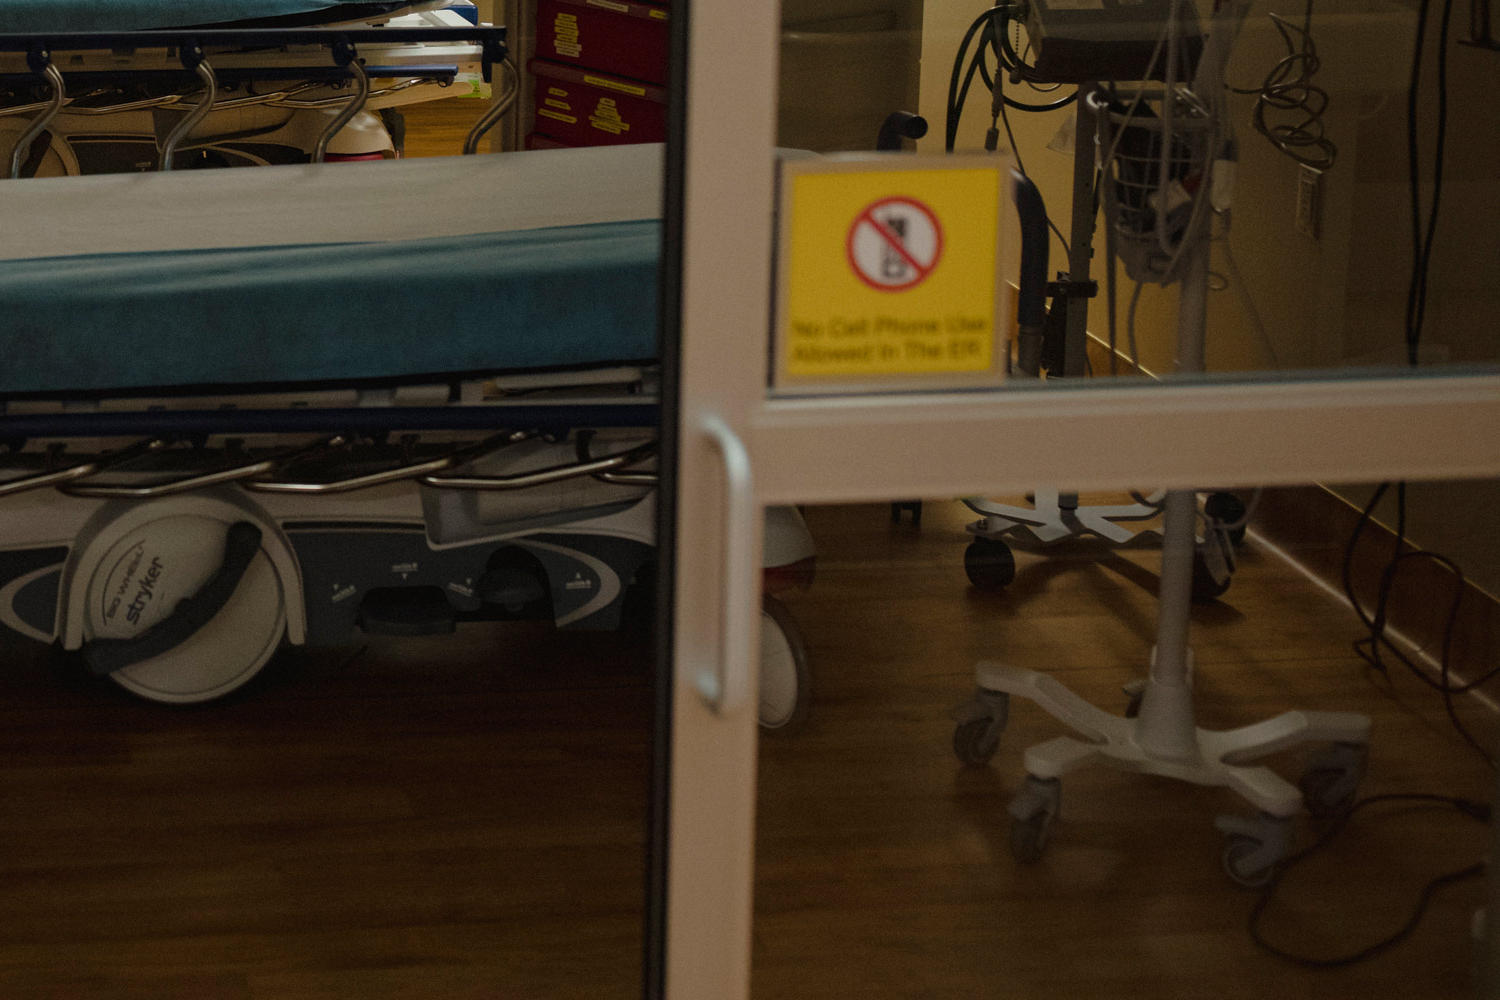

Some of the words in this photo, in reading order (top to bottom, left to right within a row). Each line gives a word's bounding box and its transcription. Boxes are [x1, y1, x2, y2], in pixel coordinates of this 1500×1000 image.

[827, 316, 868, 338] Cell
[874, 314, 941, 337] Phone
[793, 344, 873, 362] Allowed
[106, 597, 121, 619] BIG
[117, 549, 144, 595] WHEEL
[126, 556, 163, 626] stryker
